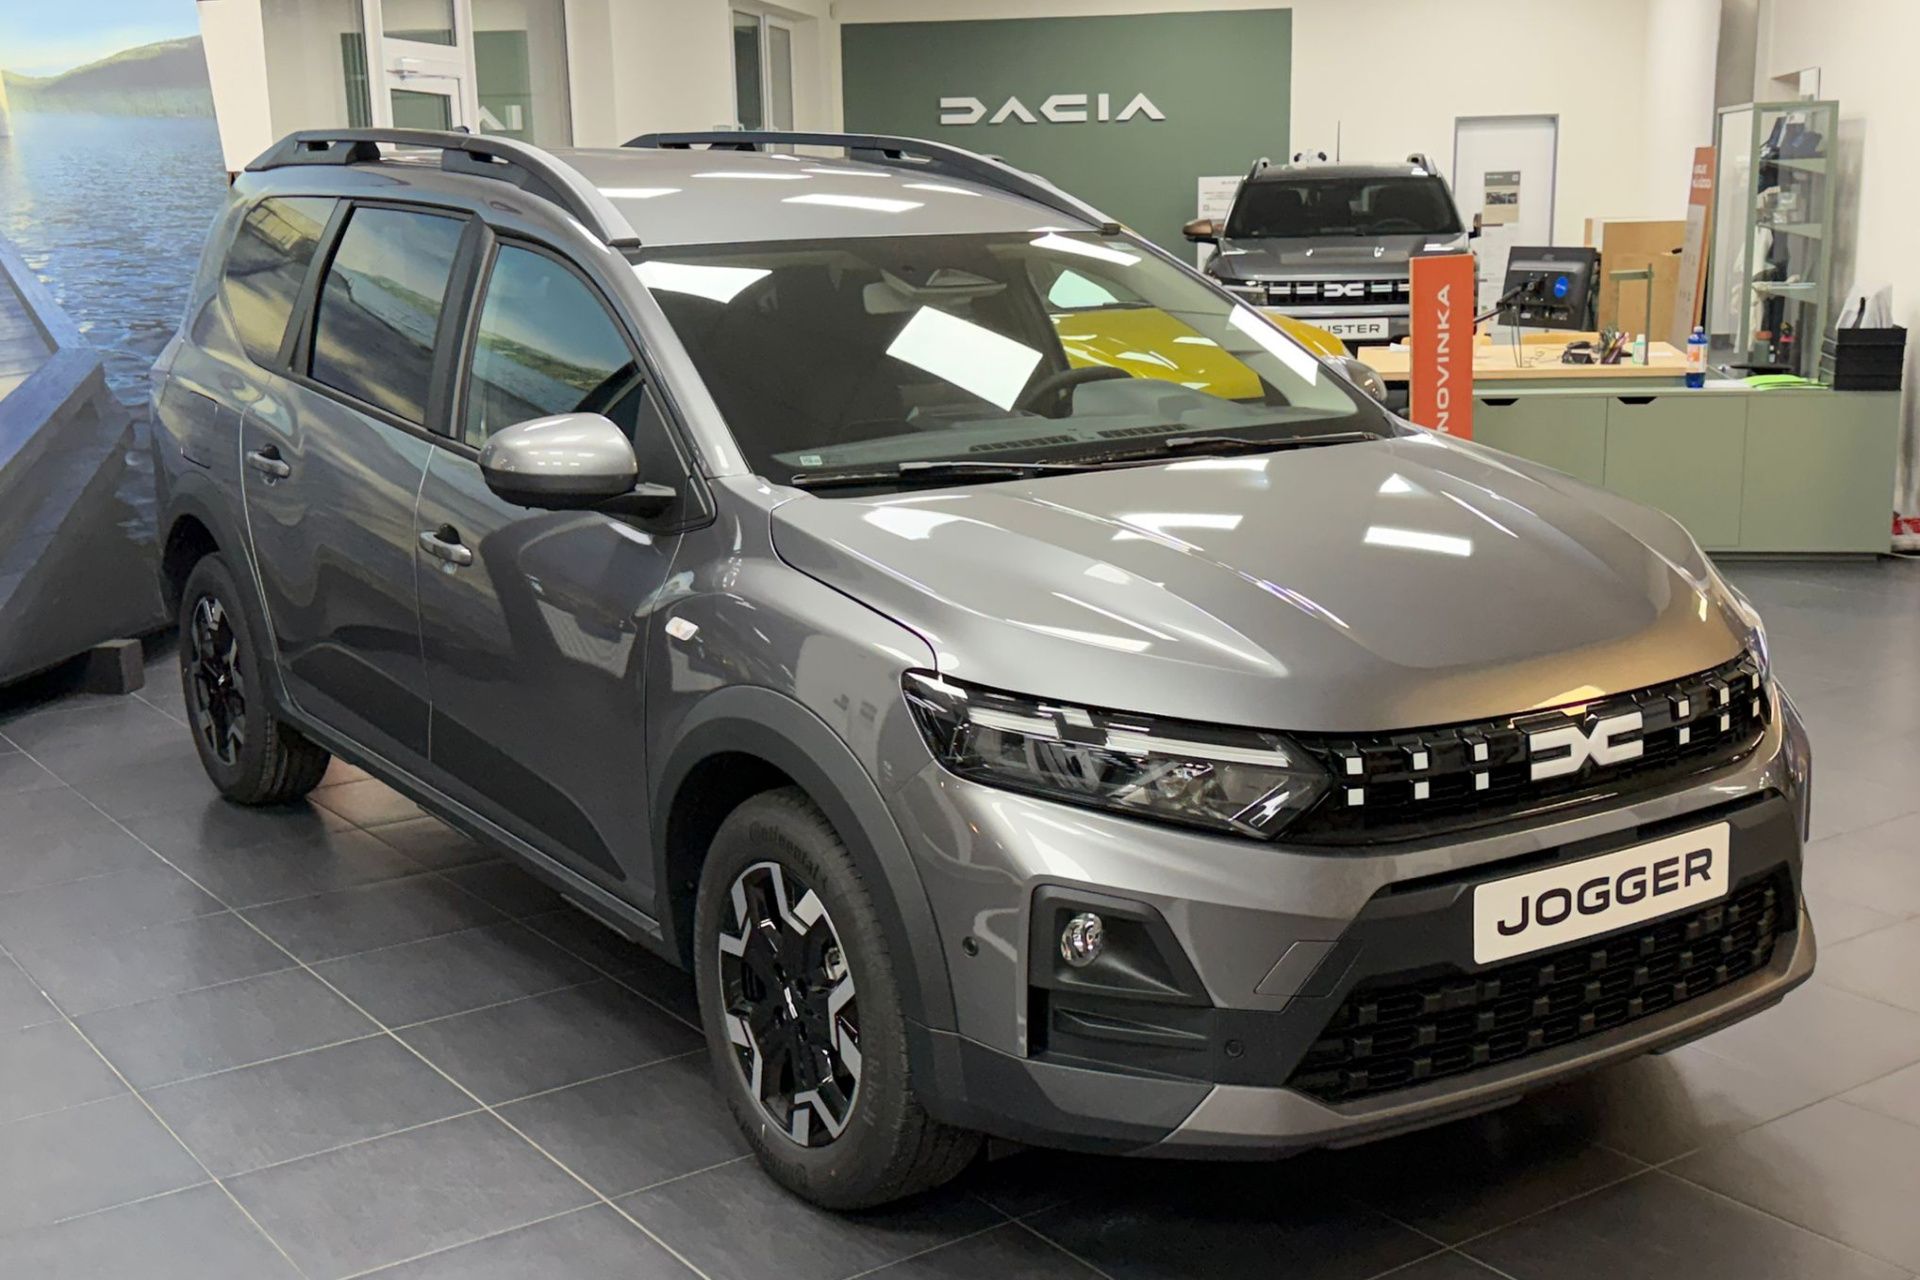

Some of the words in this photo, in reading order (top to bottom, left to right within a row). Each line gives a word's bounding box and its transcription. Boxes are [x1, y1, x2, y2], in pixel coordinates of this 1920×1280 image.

[939, 92, 1167, 125] DACIA
[1319, 323, 1381, 334] STER
[1436, 283, 1451, 433] NOVINKA
[1497, 848, 1713, 936] JOGGER
